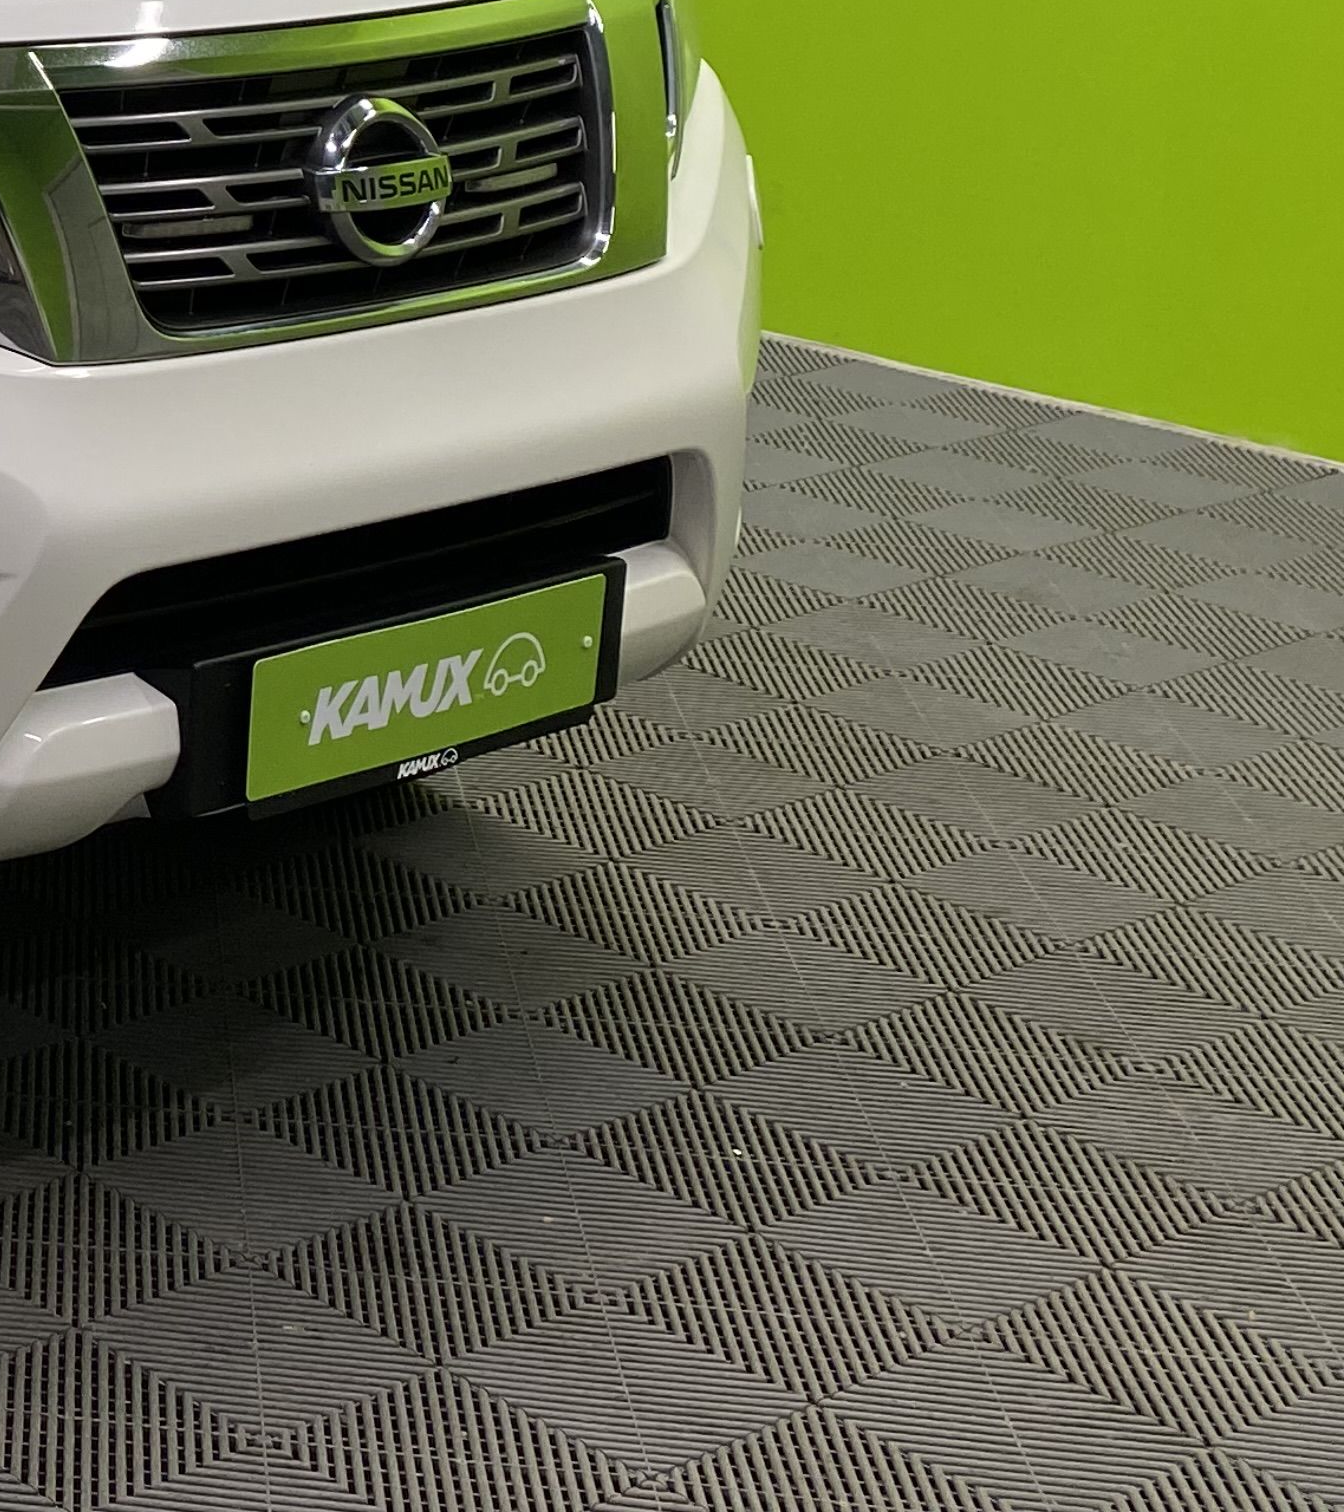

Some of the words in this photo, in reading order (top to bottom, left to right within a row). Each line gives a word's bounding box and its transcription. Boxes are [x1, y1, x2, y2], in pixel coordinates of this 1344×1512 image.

[342, 165, 449, 202] NISSAN
[308, 648, 484, 746] KAMUX
[397, 753, 441, 779] KAMUX
